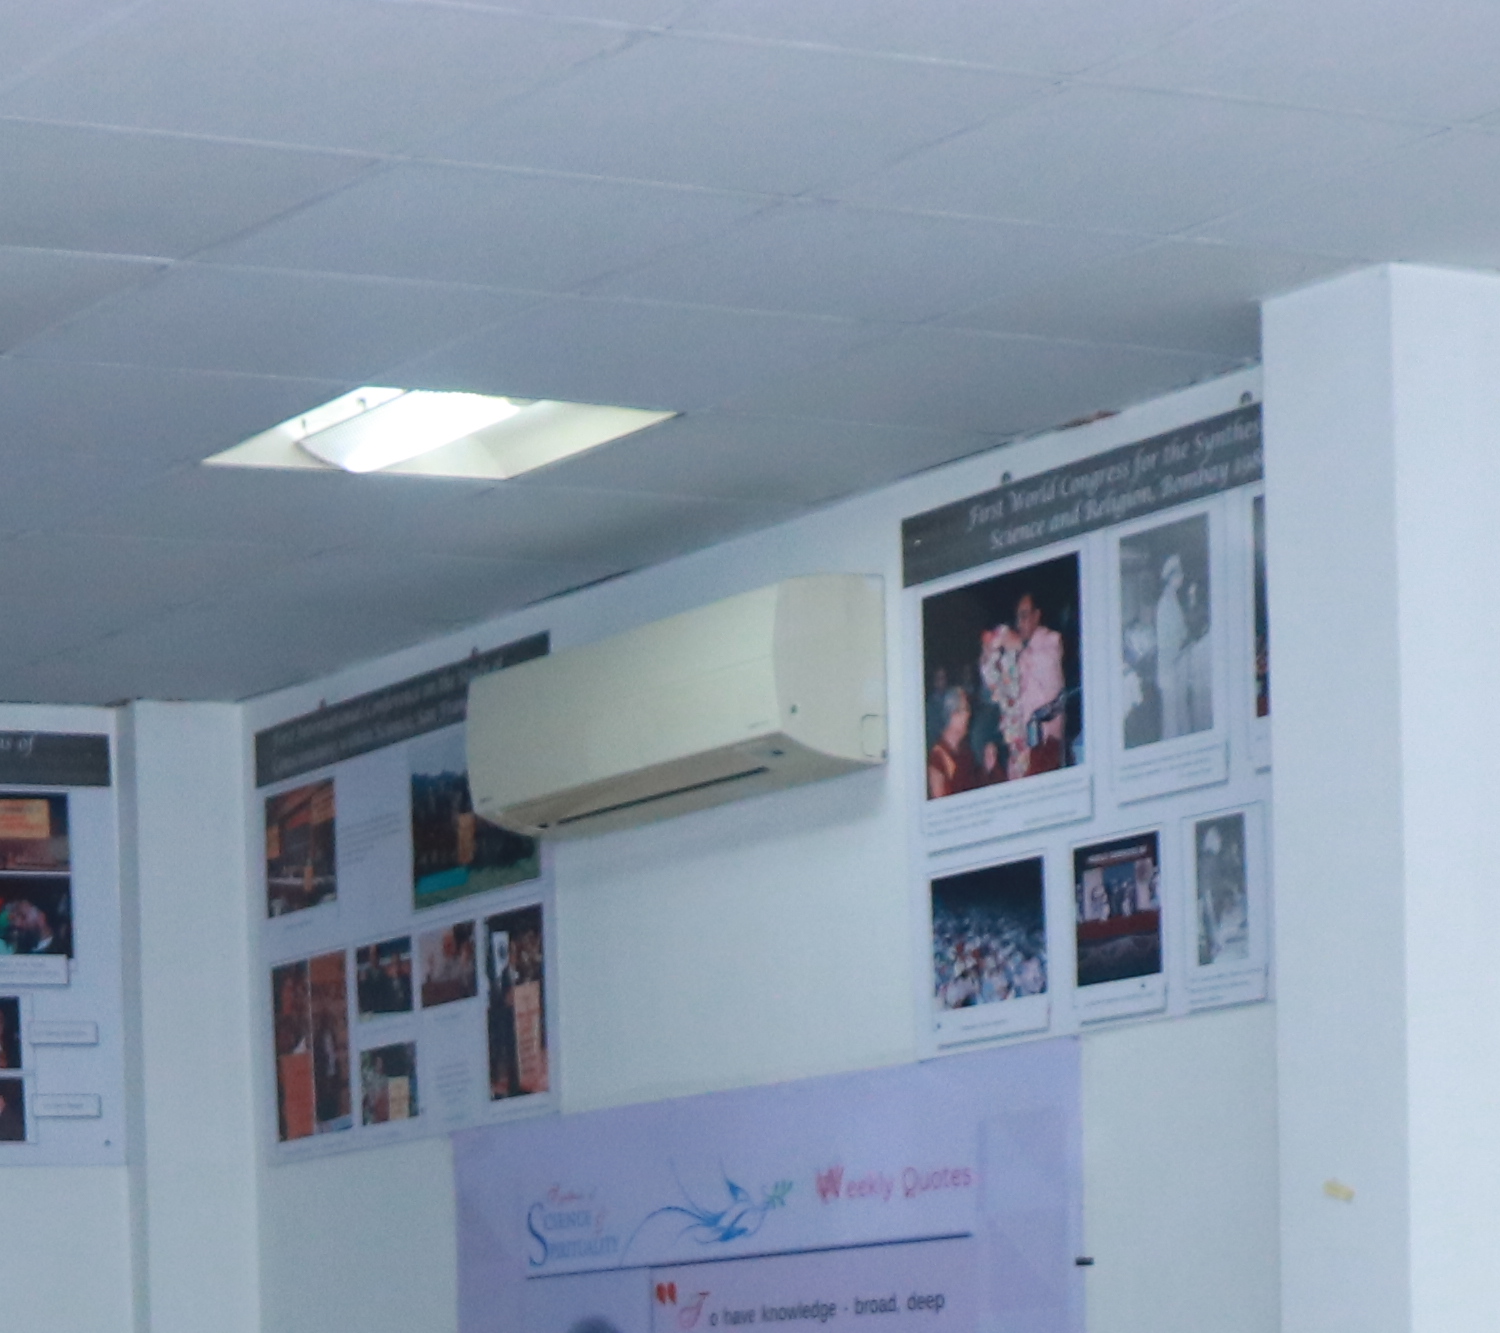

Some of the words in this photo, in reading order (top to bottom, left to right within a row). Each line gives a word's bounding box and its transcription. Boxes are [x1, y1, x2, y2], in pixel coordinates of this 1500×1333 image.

[966, 503, 1004, 534] First
[1010, 478, 1057, 511] World
[1060, 464, 1130, 499] Congress
[1130, 449, 1158, 480] for
[1162, 441, 1188, 463] the
[991, 518, 1046, 549] Science
[1047, 503, 1081, 529] and
[1160, 462, 1231, 496] Bombay
[17, 735, 34, 755] of
[815, 1165, 893, 1202] Weekly
[903, 1166, 972, 1199] Quotes
[723, 1308, 756, 1325] have
[761, 1301, 837, 1323] knowledge
[906, 1293, 945, 1313] deep
